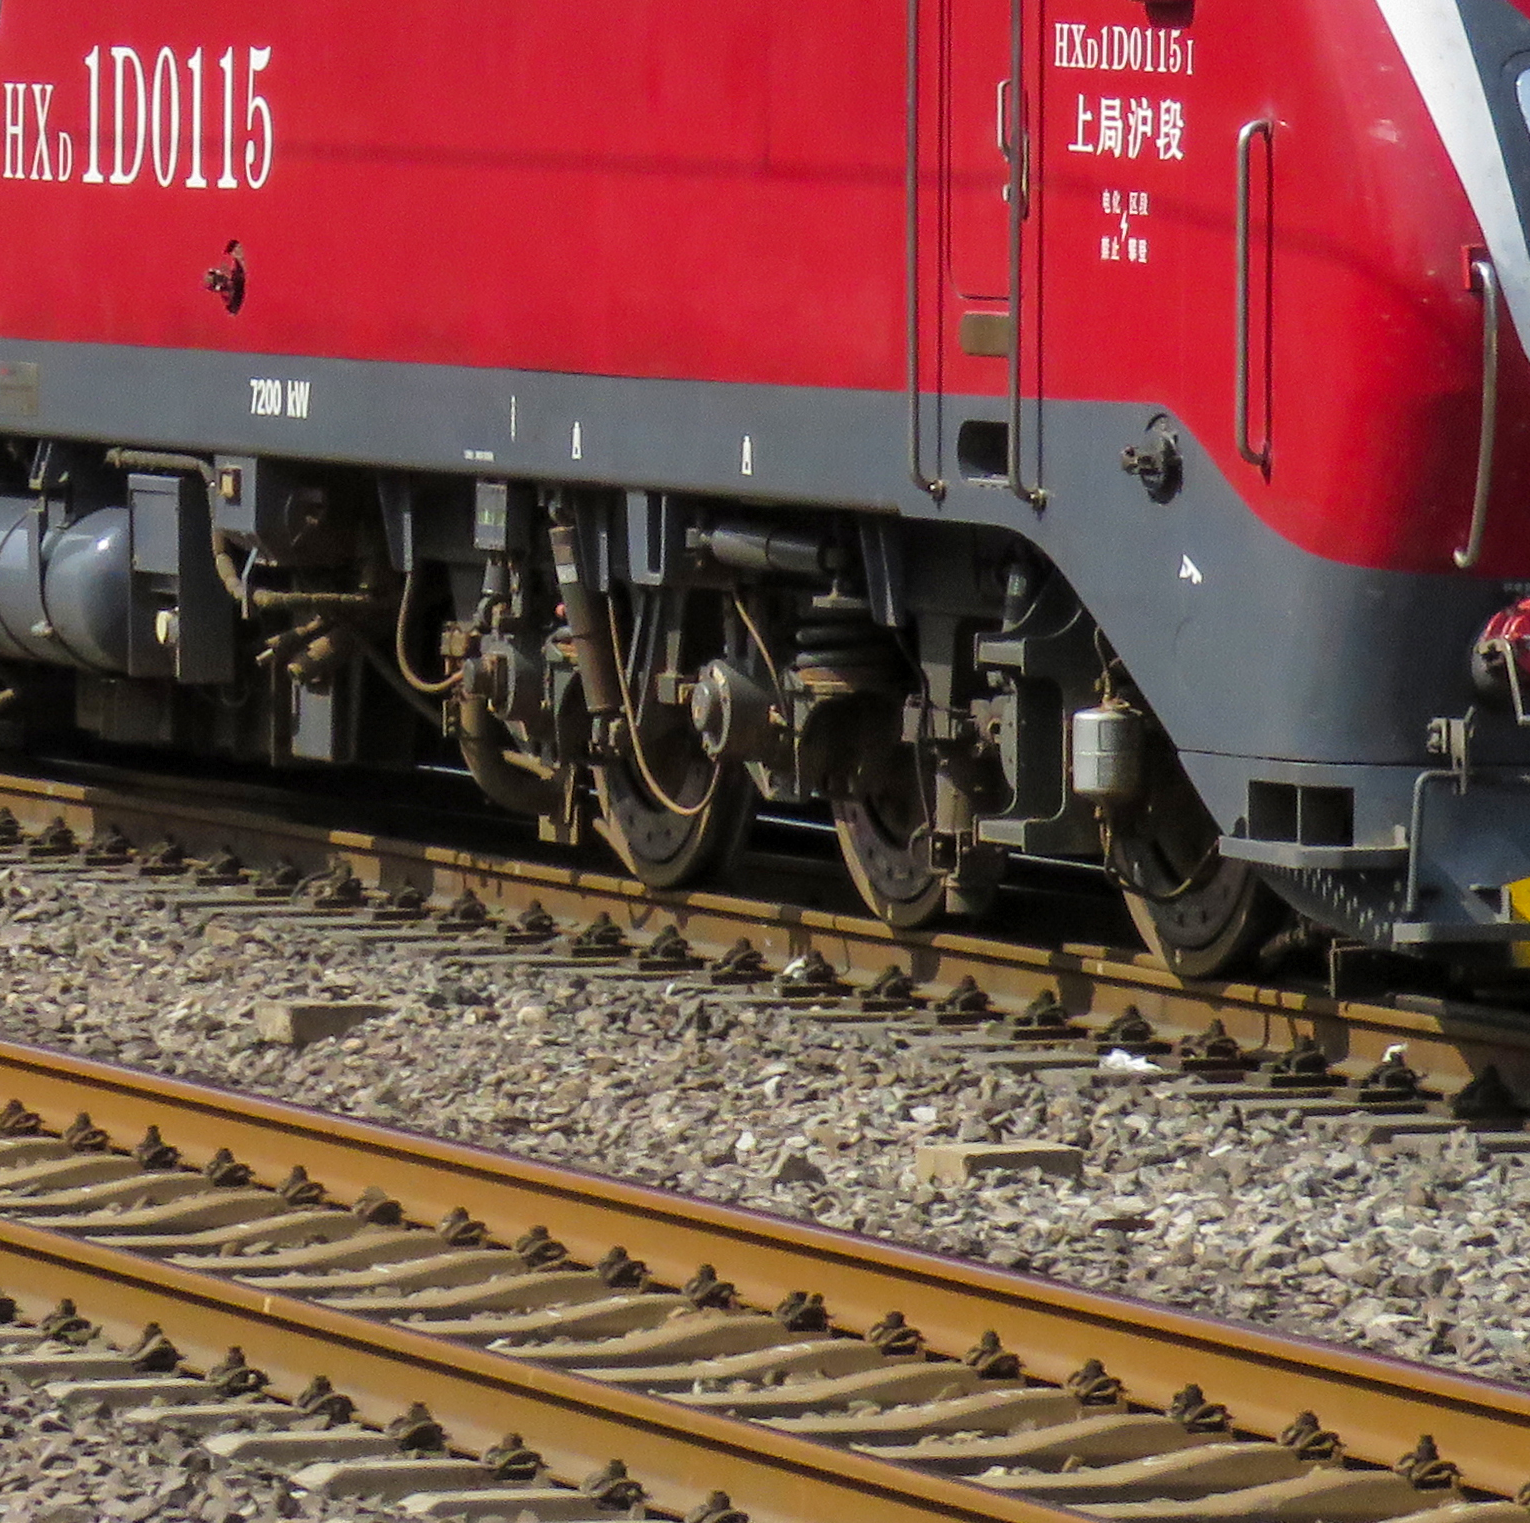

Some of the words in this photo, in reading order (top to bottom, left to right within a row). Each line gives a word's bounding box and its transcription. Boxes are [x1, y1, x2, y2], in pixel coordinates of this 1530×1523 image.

[1067, 93, 1185, 161] 上局沪段
[249, 378, 282, 416] 7200
[286, 379, 311, 419] kW
